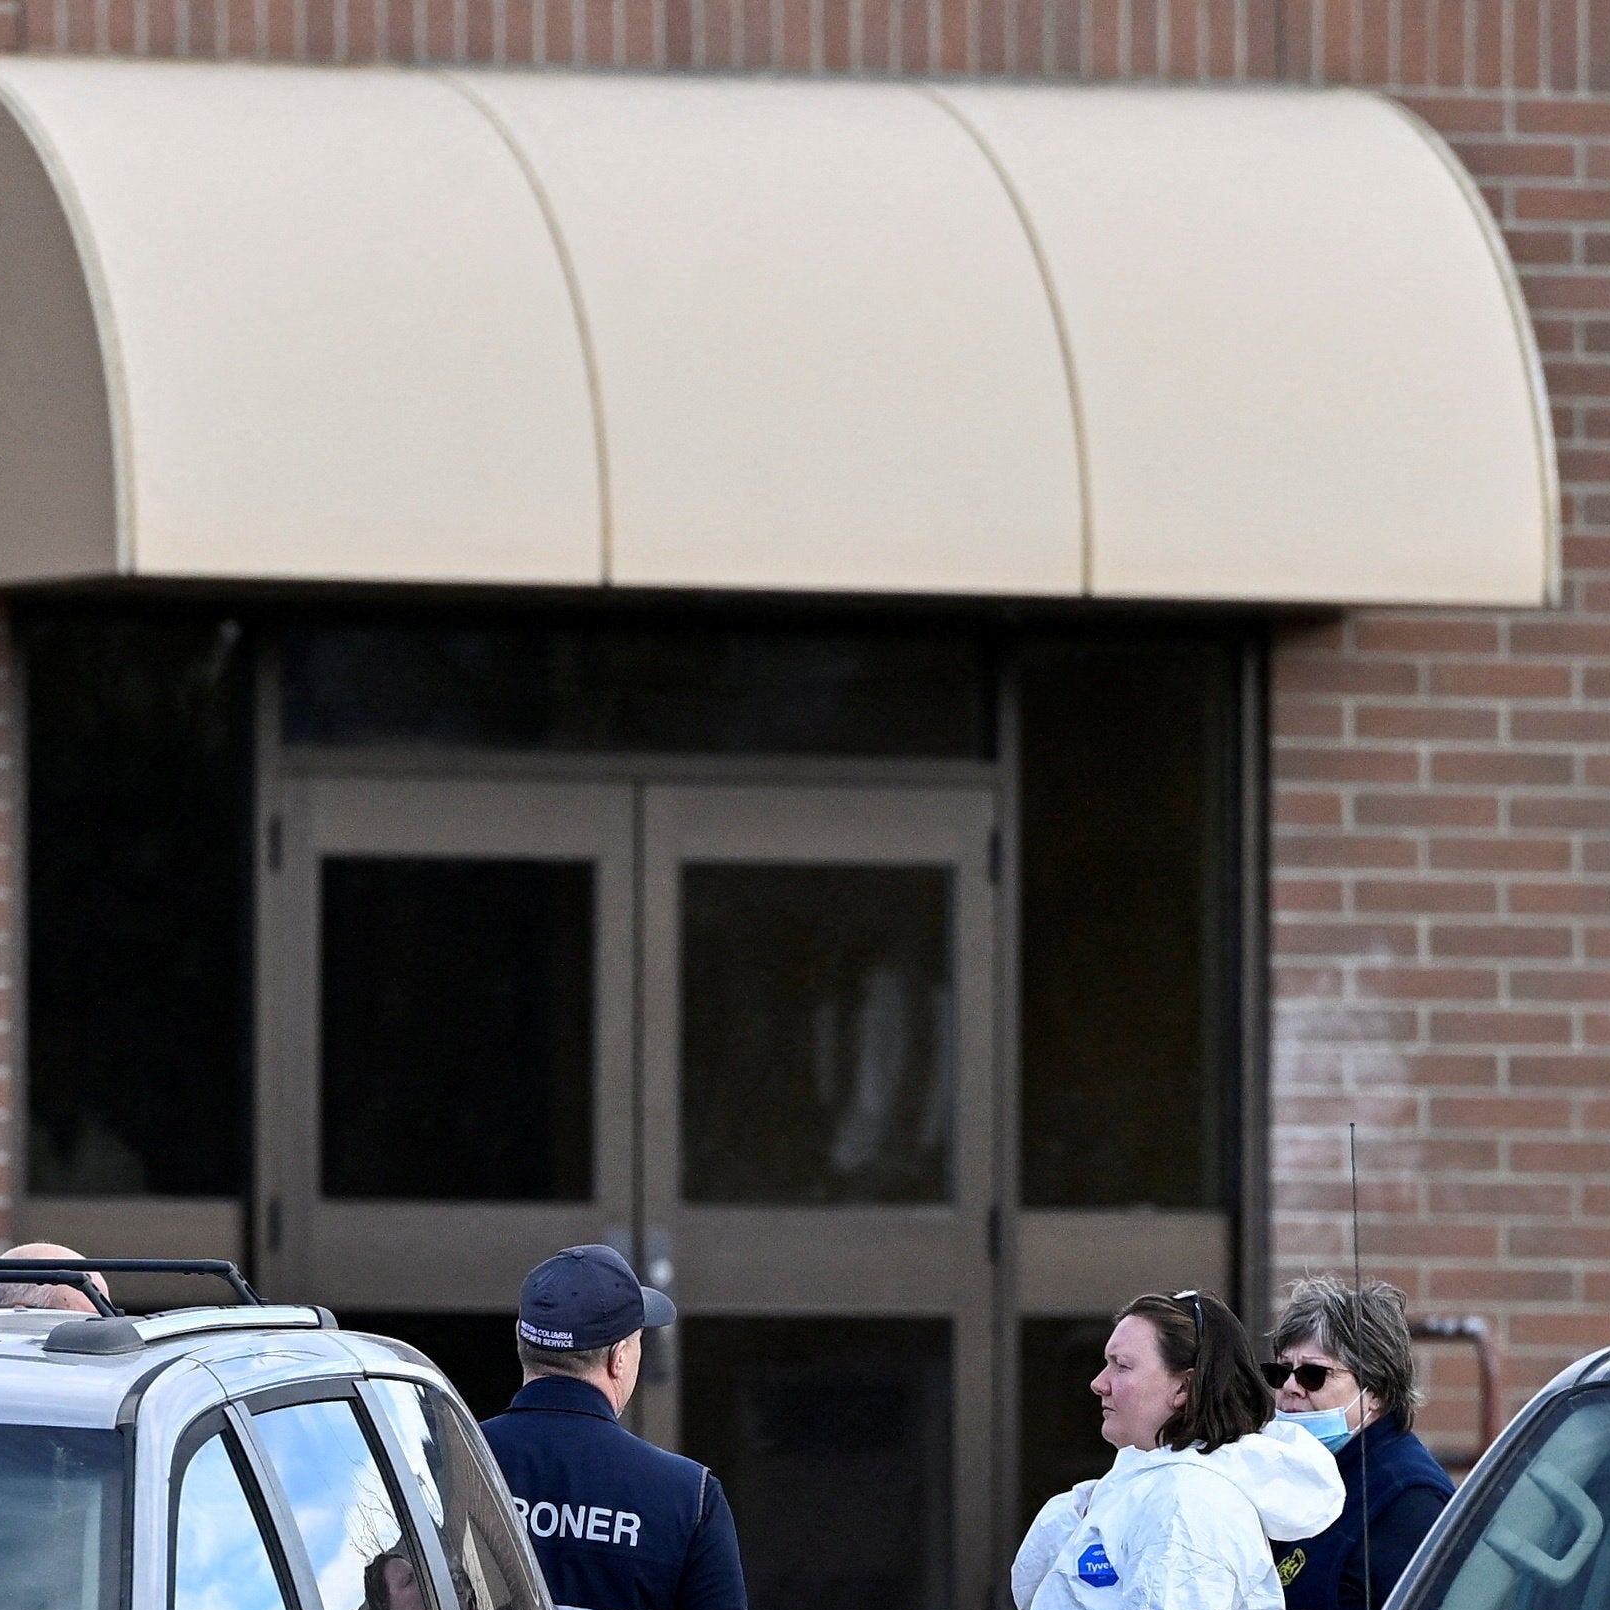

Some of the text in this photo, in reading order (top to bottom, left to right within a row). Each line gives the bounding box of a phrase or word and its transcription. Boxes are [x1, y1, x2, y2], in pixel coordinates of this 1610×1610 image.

[538, 1329, 573, 1340] COLUMBIA
[542, 1338, 574, 1348] SERVICE
[1086, 1561, 1114, 1573] Tyve
